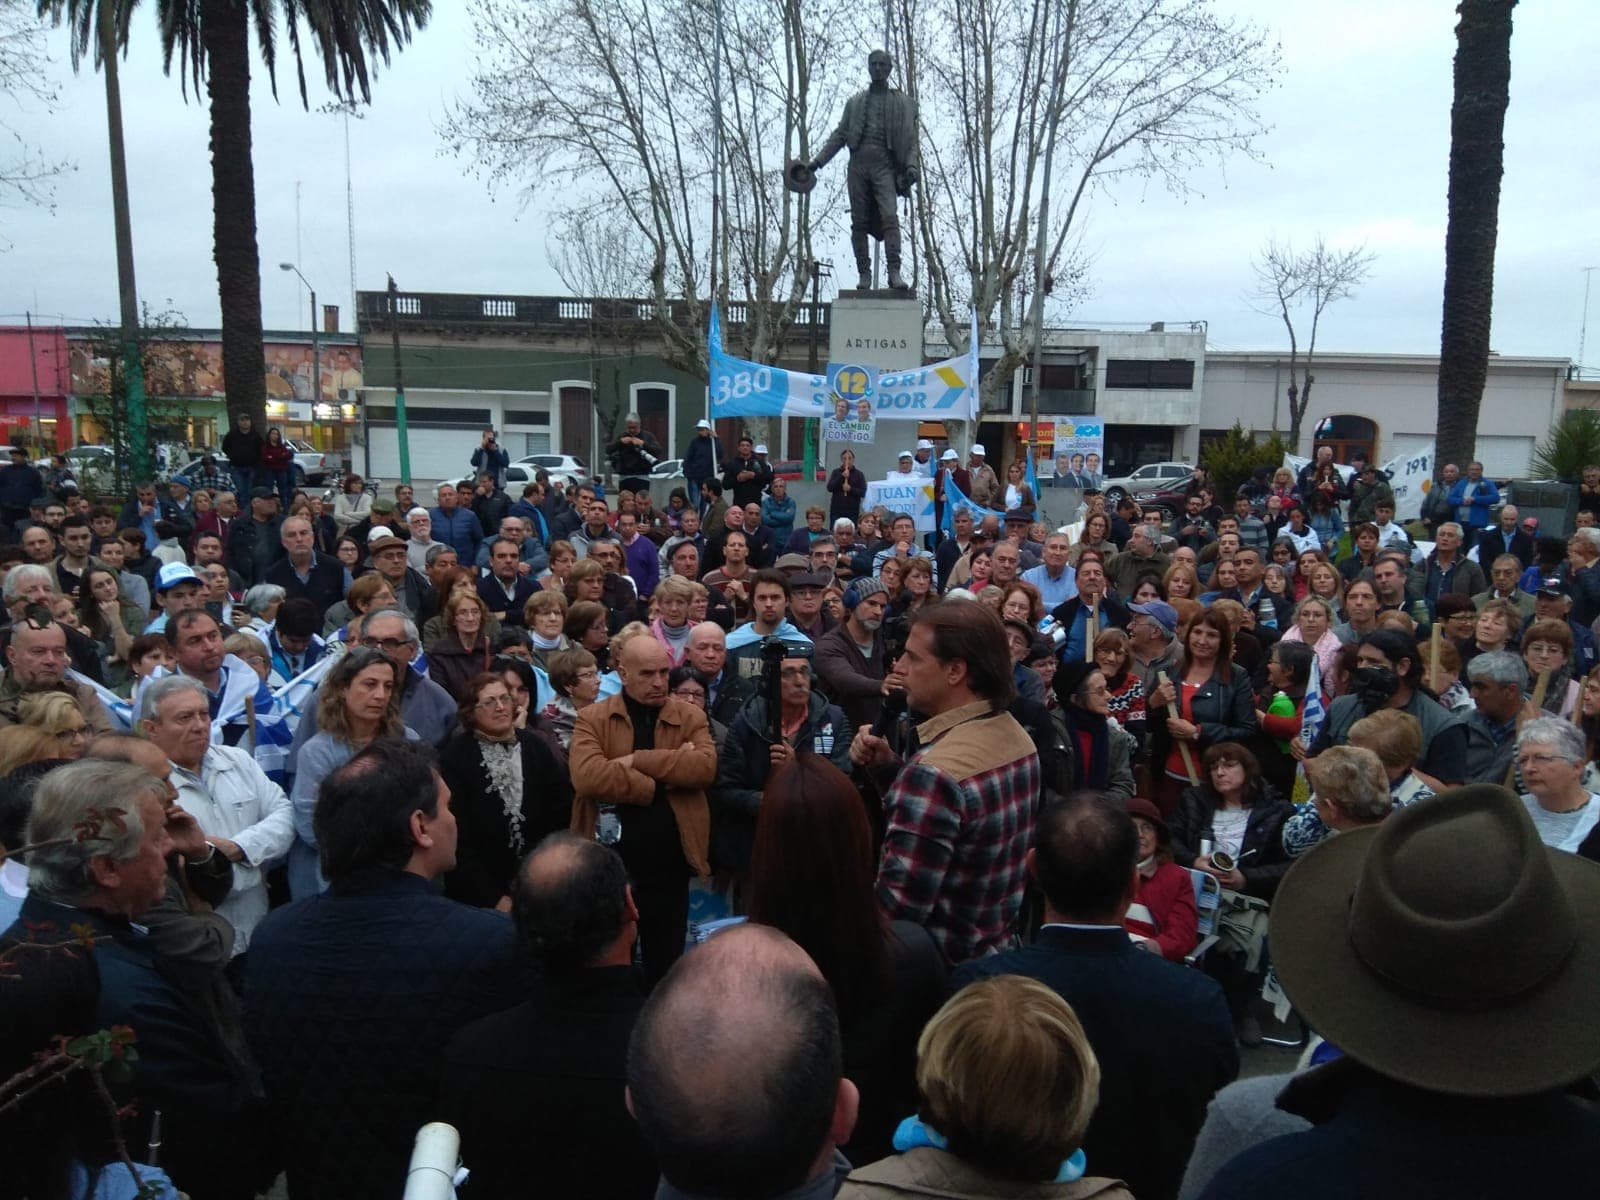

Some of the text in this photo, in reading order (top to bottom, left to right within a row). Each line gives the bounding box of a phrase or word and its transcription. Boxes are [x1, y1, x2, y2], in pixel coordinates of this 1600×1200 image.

[846, 338, 907, 349] ARTIGAS
[713, 367, 772, 406] 380
[839, 371, 867, 395] 12
[811, 392, 928, 409] SDOR
[828, 421, 871, 432] EL CAMBIO
[827, 431, 870, 441] CONTIGO
[876, 486, 917, 503] JUAN
